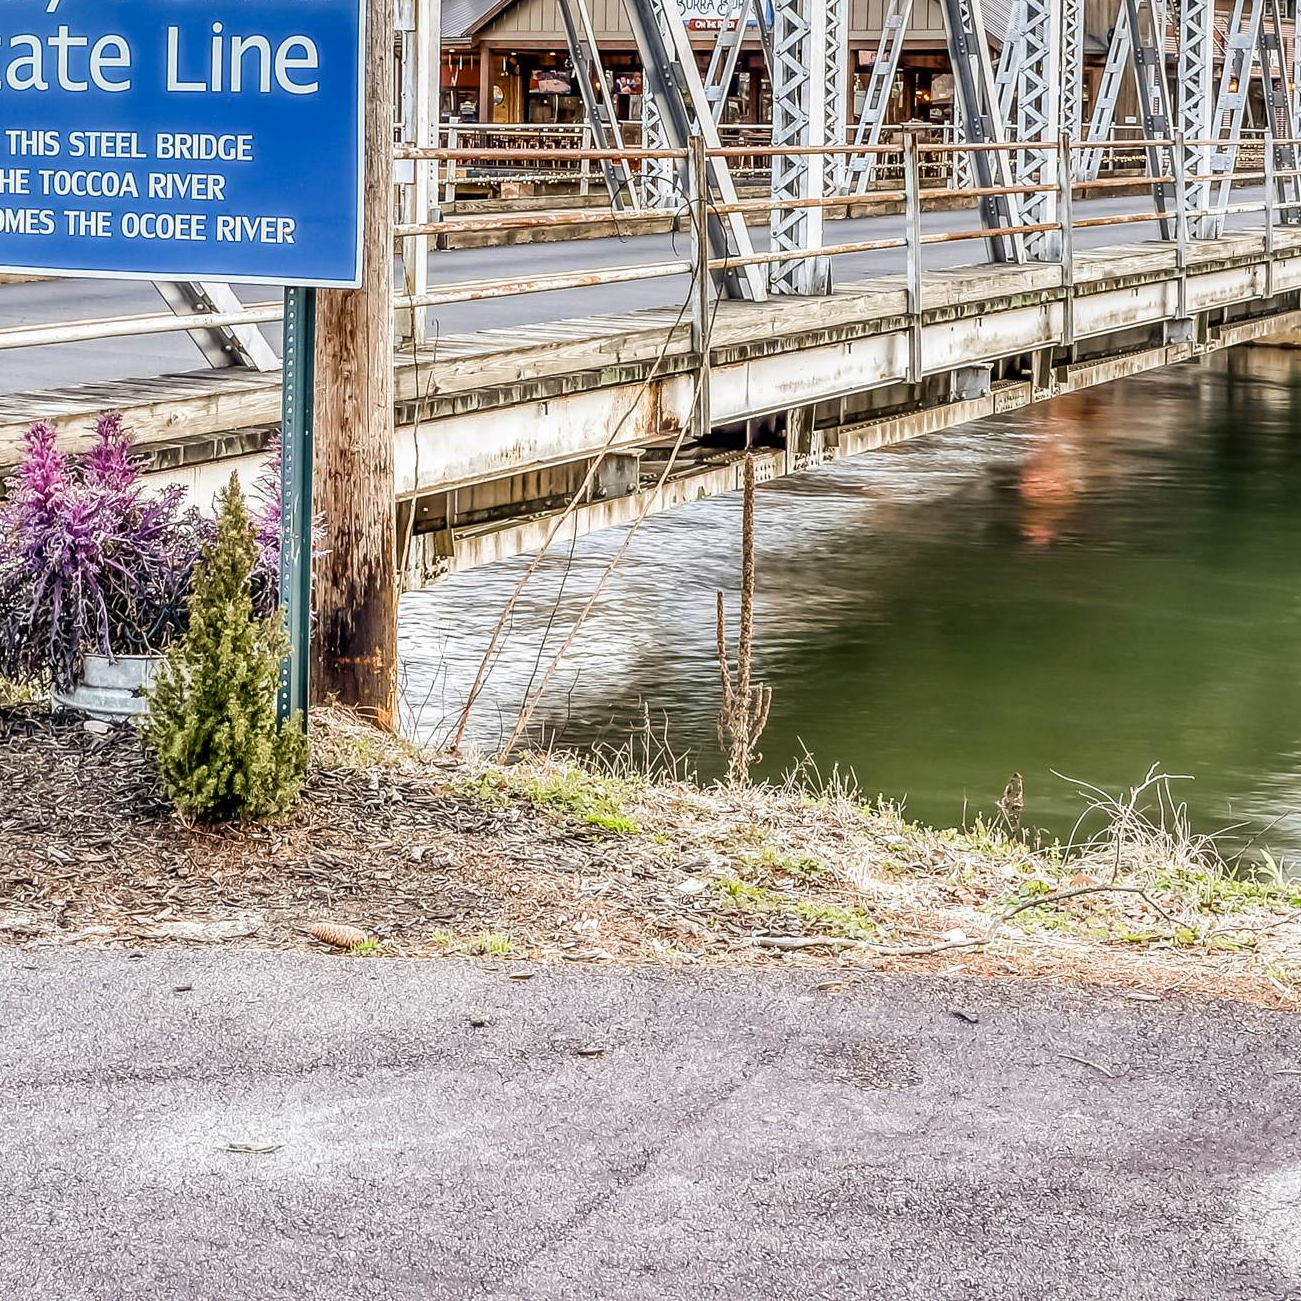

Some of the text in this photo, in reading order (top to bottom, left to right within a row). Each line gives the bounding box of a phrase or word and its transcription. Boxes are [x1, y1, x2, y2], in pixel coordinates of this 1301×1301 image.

[166, 21, 320, 95] Line
[5, 129, 61, 157] THIS
[68, 131, 148, 159] STEEL
[155, 133, 254, 161] BRIDGE
[38, 170, 139, 198] TOCCOA
[148, 172, 227, 201] RIVER
[63, 210, 113, 237] THE
[121, 212, 208, 242] OCOEE
[216, 215, 297, 245] RIVER
